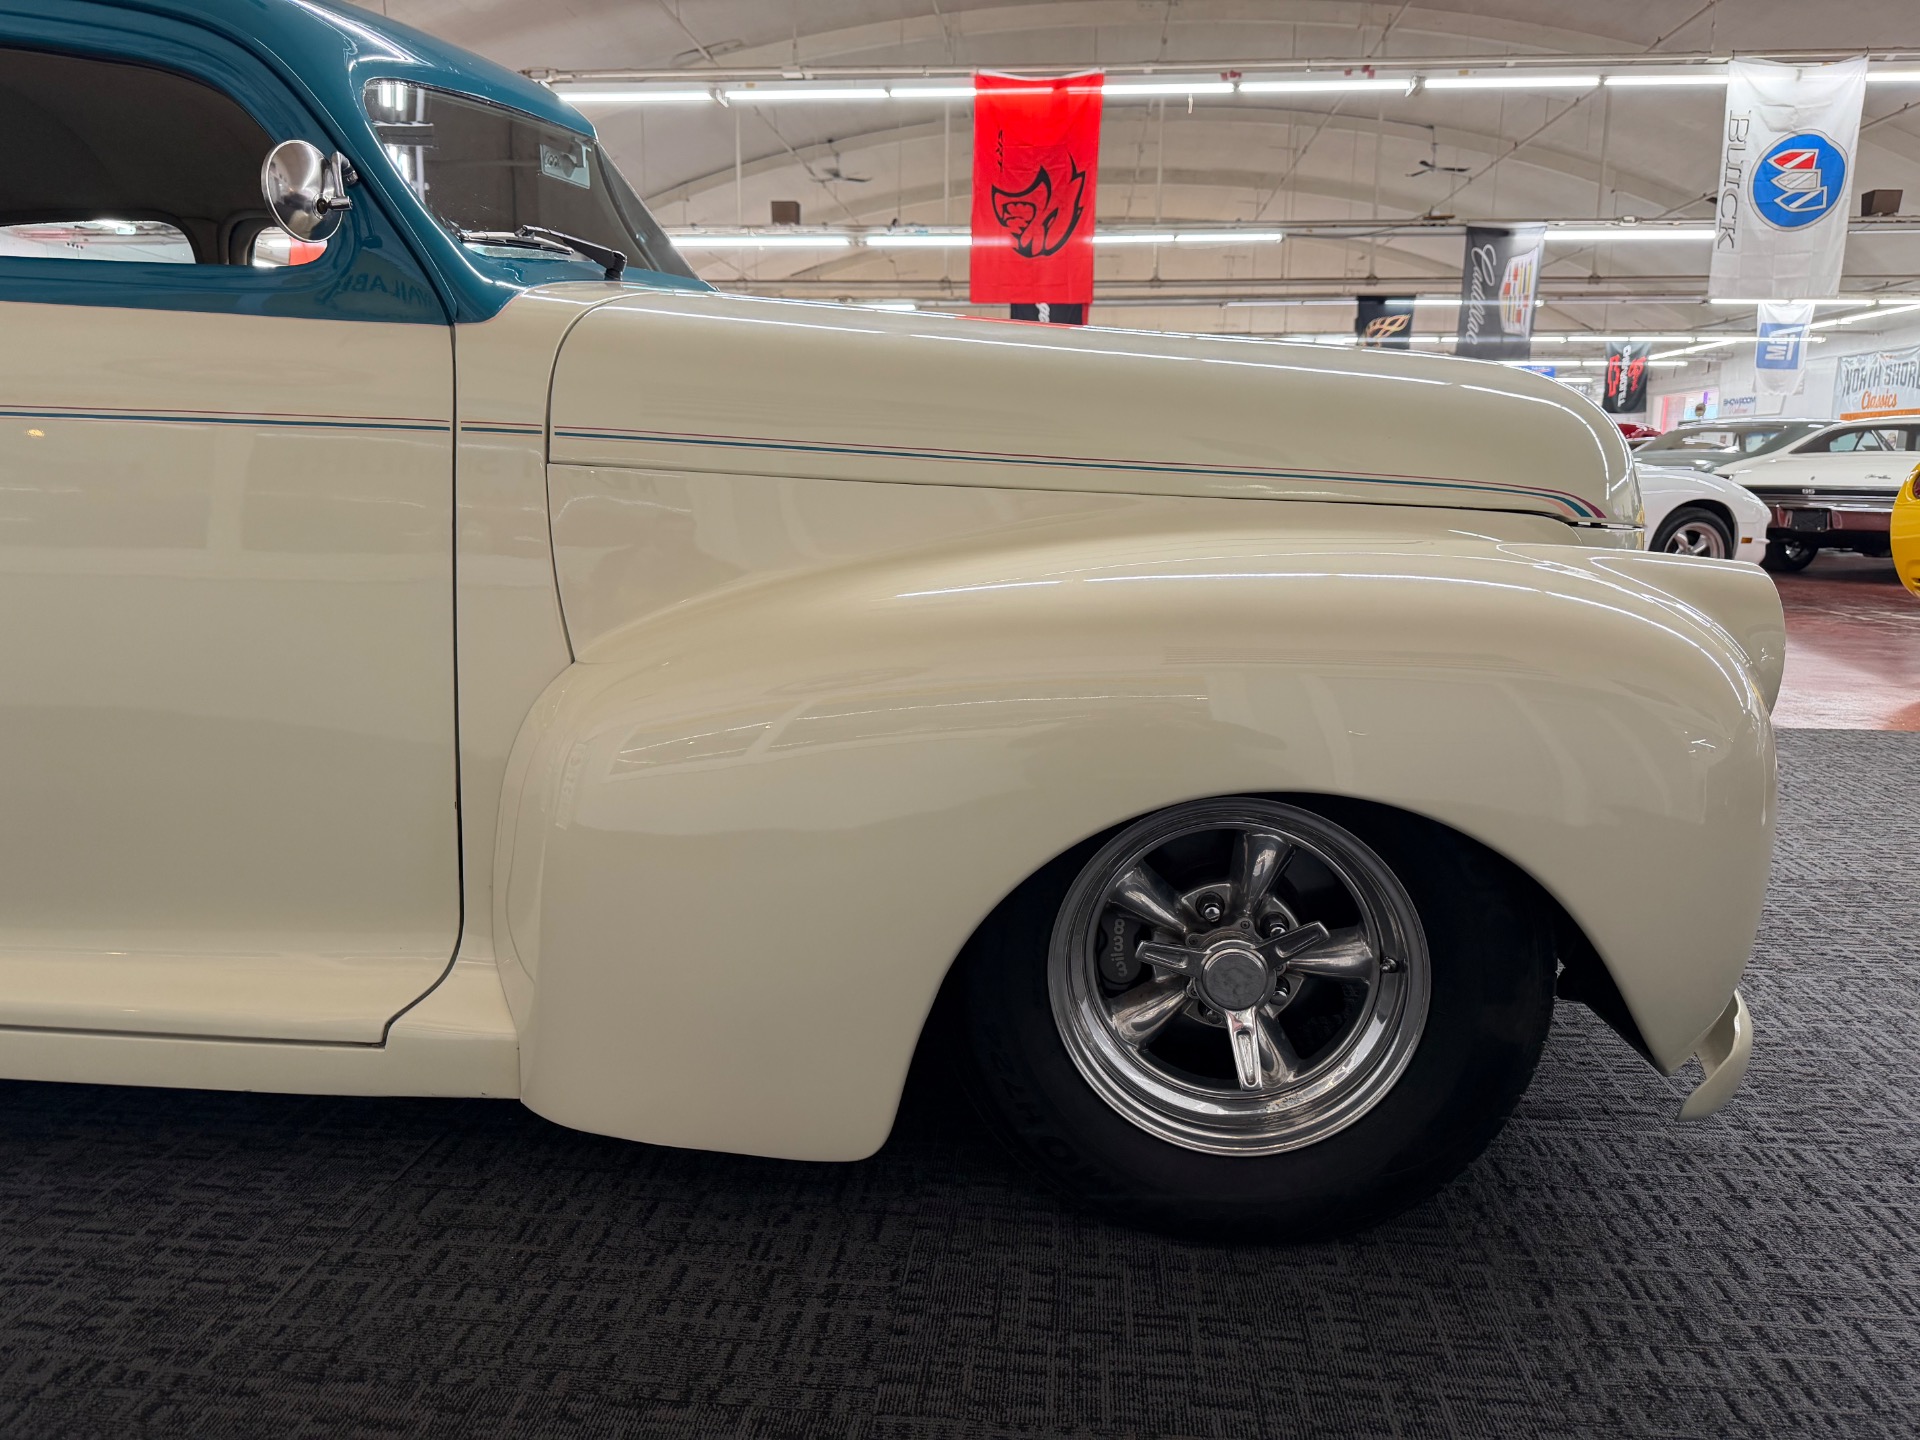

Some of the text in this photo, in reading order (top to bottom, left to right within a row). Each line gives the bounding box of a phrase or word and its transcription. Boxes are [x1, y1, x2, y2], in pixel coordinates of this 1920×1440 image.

[1717, 110, 1751, 249] BUICK
[1466, 244, 1496, 345] Cadillac
[1842, 365, 1882, 398] NORTH
[1861, 390, 1897, 410] Classics
[1110, 918, 1128, 977] wilwoo
